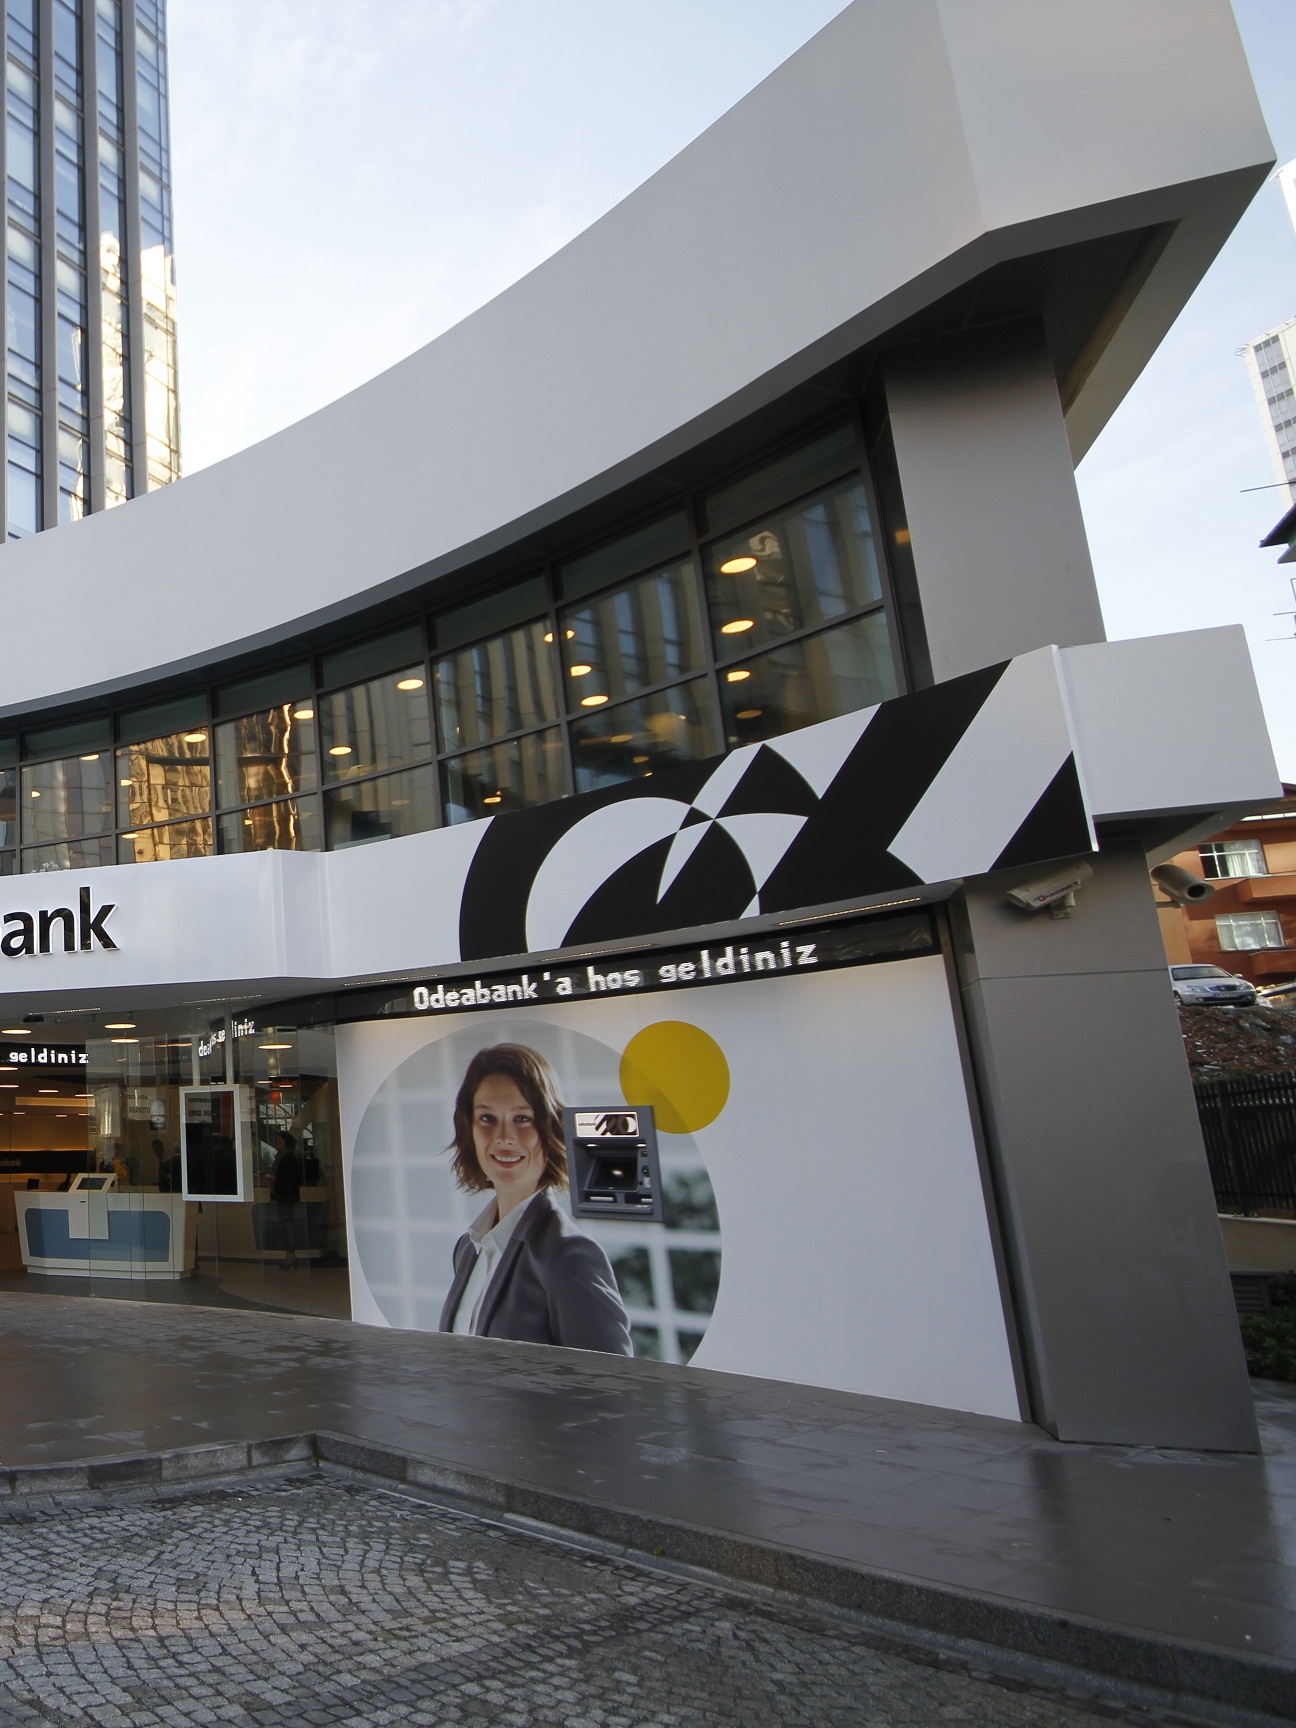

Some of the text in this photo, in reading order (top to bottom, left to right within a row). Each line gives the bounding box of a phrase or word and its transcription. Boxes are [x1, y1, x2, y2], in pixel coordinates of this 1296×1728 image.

[412, 940, 819, 1011] Odeabank'a hos geldiniz
[9, 1048, 89, 1064] geldiniz
